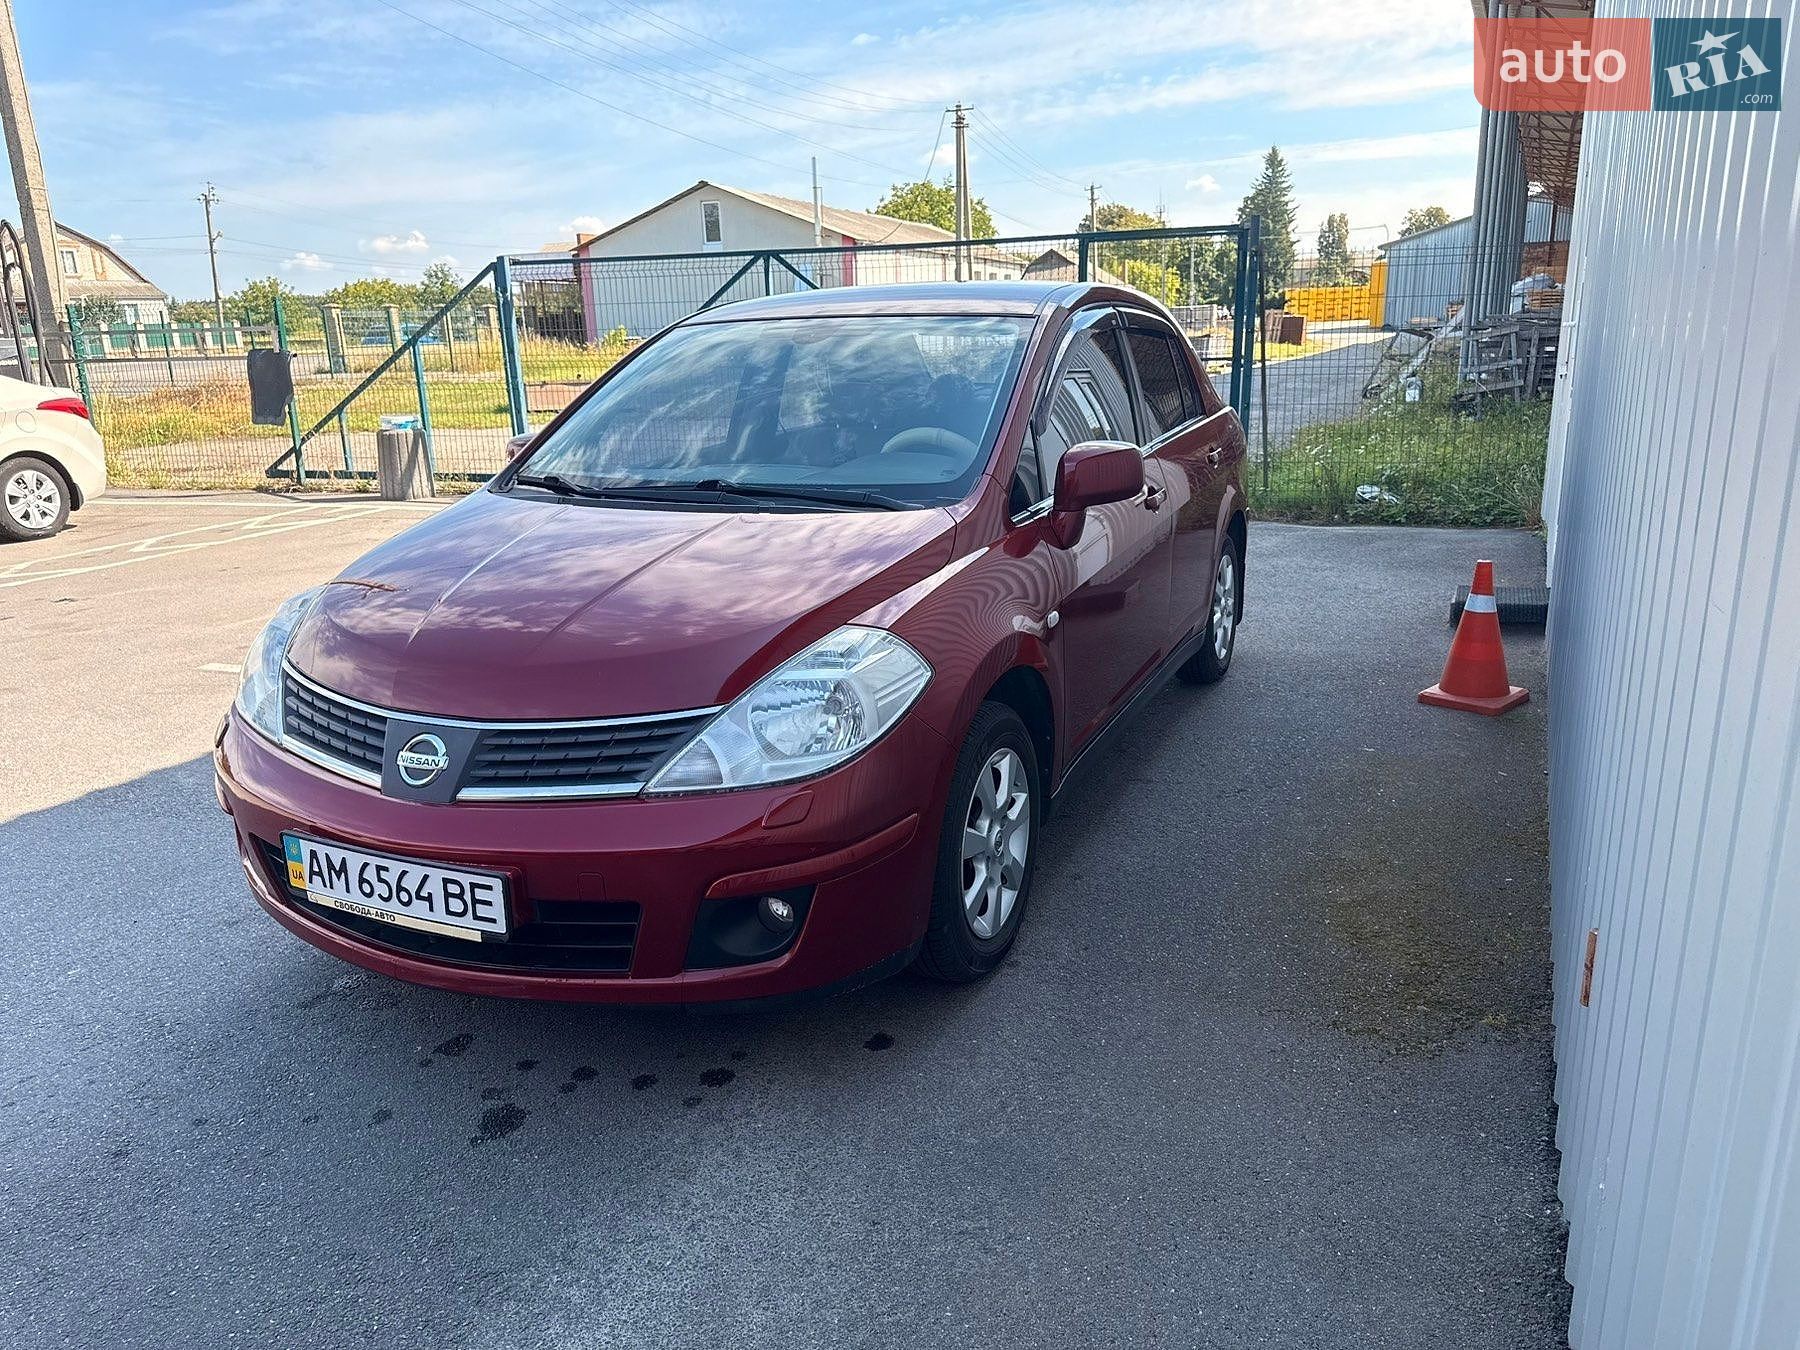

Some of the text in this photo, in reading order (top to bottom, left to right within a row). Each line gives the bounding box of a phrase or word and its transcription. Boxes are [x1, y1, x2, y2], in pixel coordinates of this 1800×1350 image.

[400, 754, 441, 767] NISSAN
[291, 869, 305, 882] UA
[308, 848, 498, 924] AM 6564 BE
[333, 900, 396, 922] СВОБОДА-АВТО
